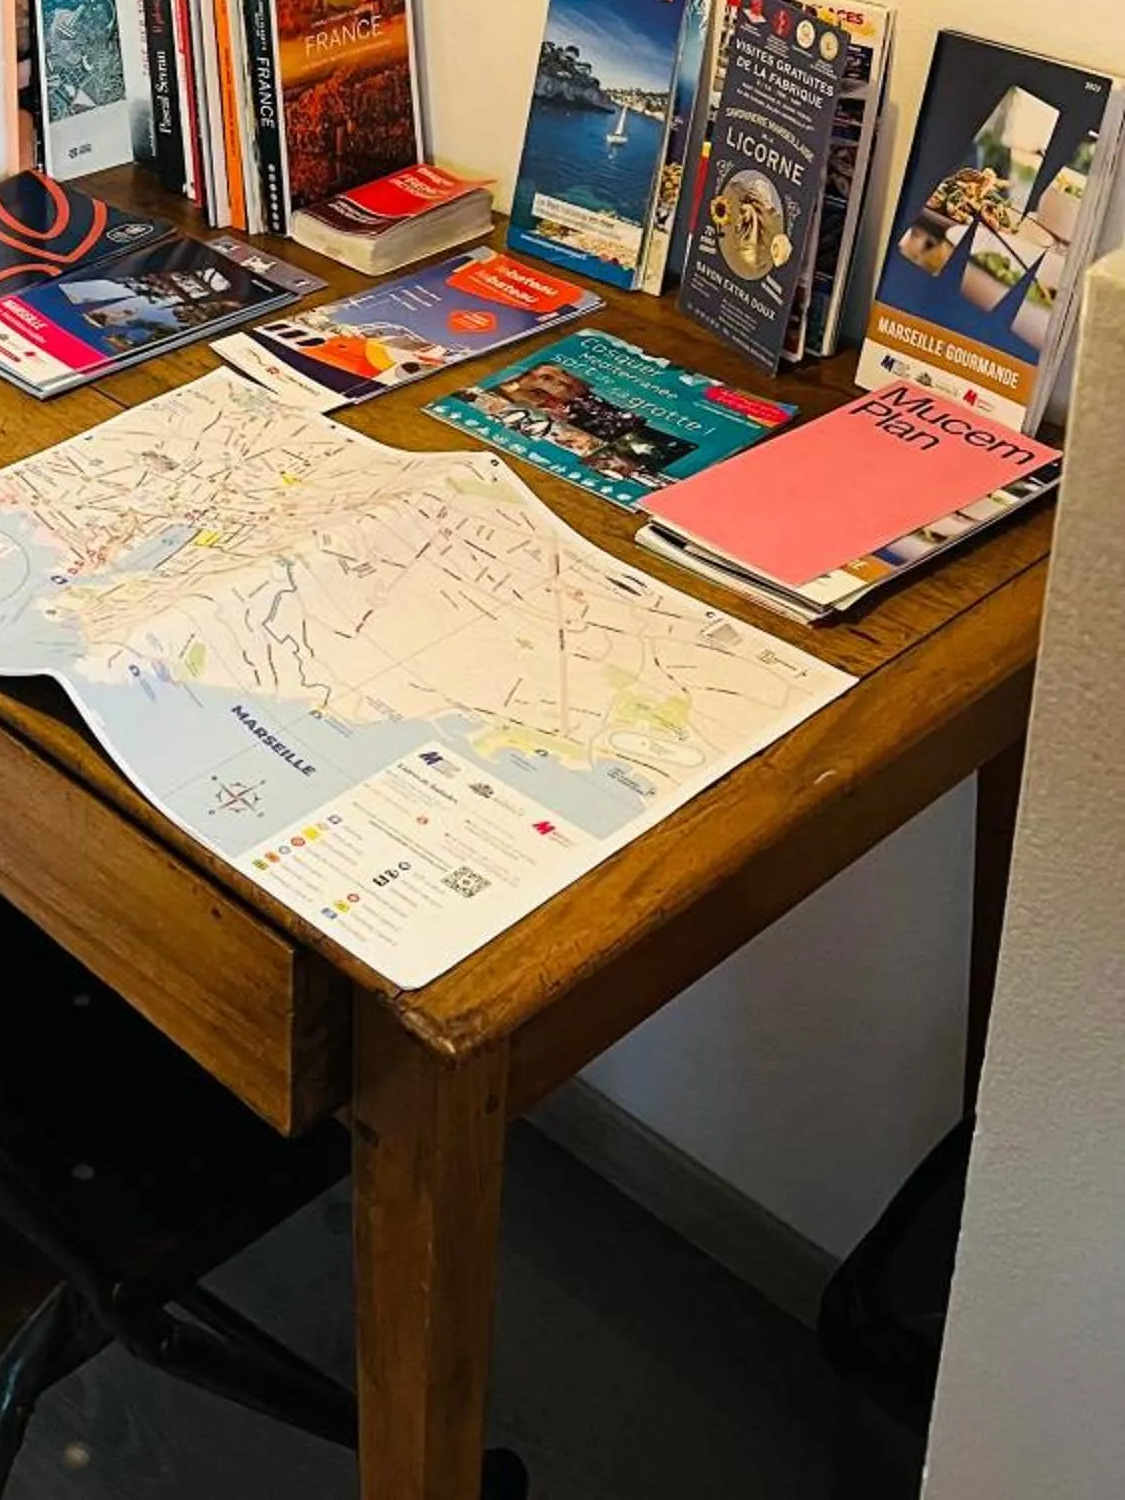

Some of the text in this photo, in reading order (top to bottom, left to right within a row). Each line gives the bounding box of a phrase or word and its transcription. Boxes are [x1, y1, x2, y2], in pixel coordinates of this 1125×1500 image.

[305, 14, 383, 58] FRANCE
[256, 56, 276, 129] FRANCE
[736, 38, 774, 67] VISITES
[776, 57, 834, 97] GRATUITES
[736, 56, 824, 109] DE LA FABRIQUE
[726, 126, 805, 187] LICORNE
[723, 279, 750, 303] EXTRA
[751, 297, 776, 321] DOUX
[580, 337, 665, 378] Cosquer
[878, 316, 1020, 390] MARSEILLE GOURMANDE
[551, 353, 597, 377] sort
[627, 396, 703, 430] grotte
[850, 401, 940, 450] Plan
[880, 387, 1036, 465] Mucem
[231, 705, 317, 777] MARSEILLE
